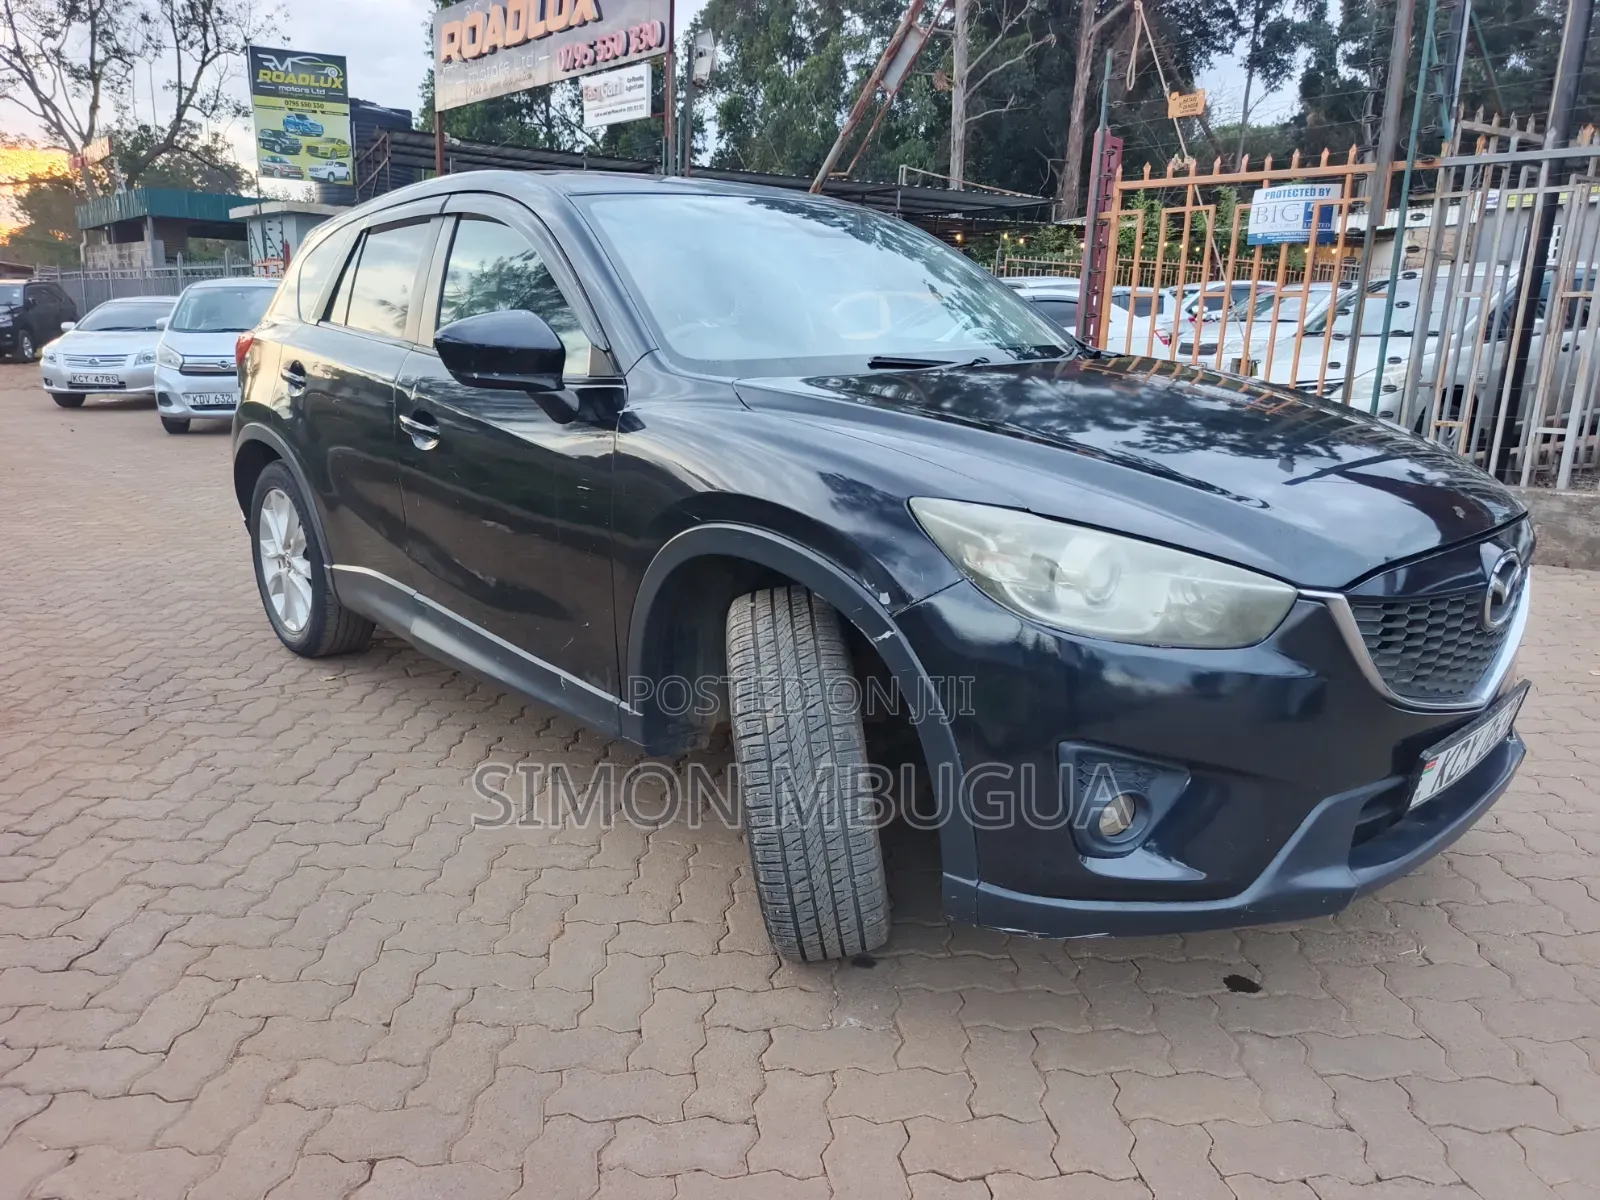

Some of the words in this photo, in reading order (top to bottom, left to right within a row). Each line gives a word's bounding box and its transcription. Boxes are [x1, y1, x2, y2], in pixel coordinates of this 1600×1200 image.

[558, 42, 595, 71] 0795
[596, 30, 628, 61] 550
[629, 19, 664, 53] 330
[259, 69, 344, 89] ROADLUX
[279, 85, 310, 93] motors
[1264, 187, 1316, 200] PROTECTED
[1318, 187, 1331, 197] BY
[1253, 203, 1300, 225] BIG
[72, 374, 89, 383] KCY
